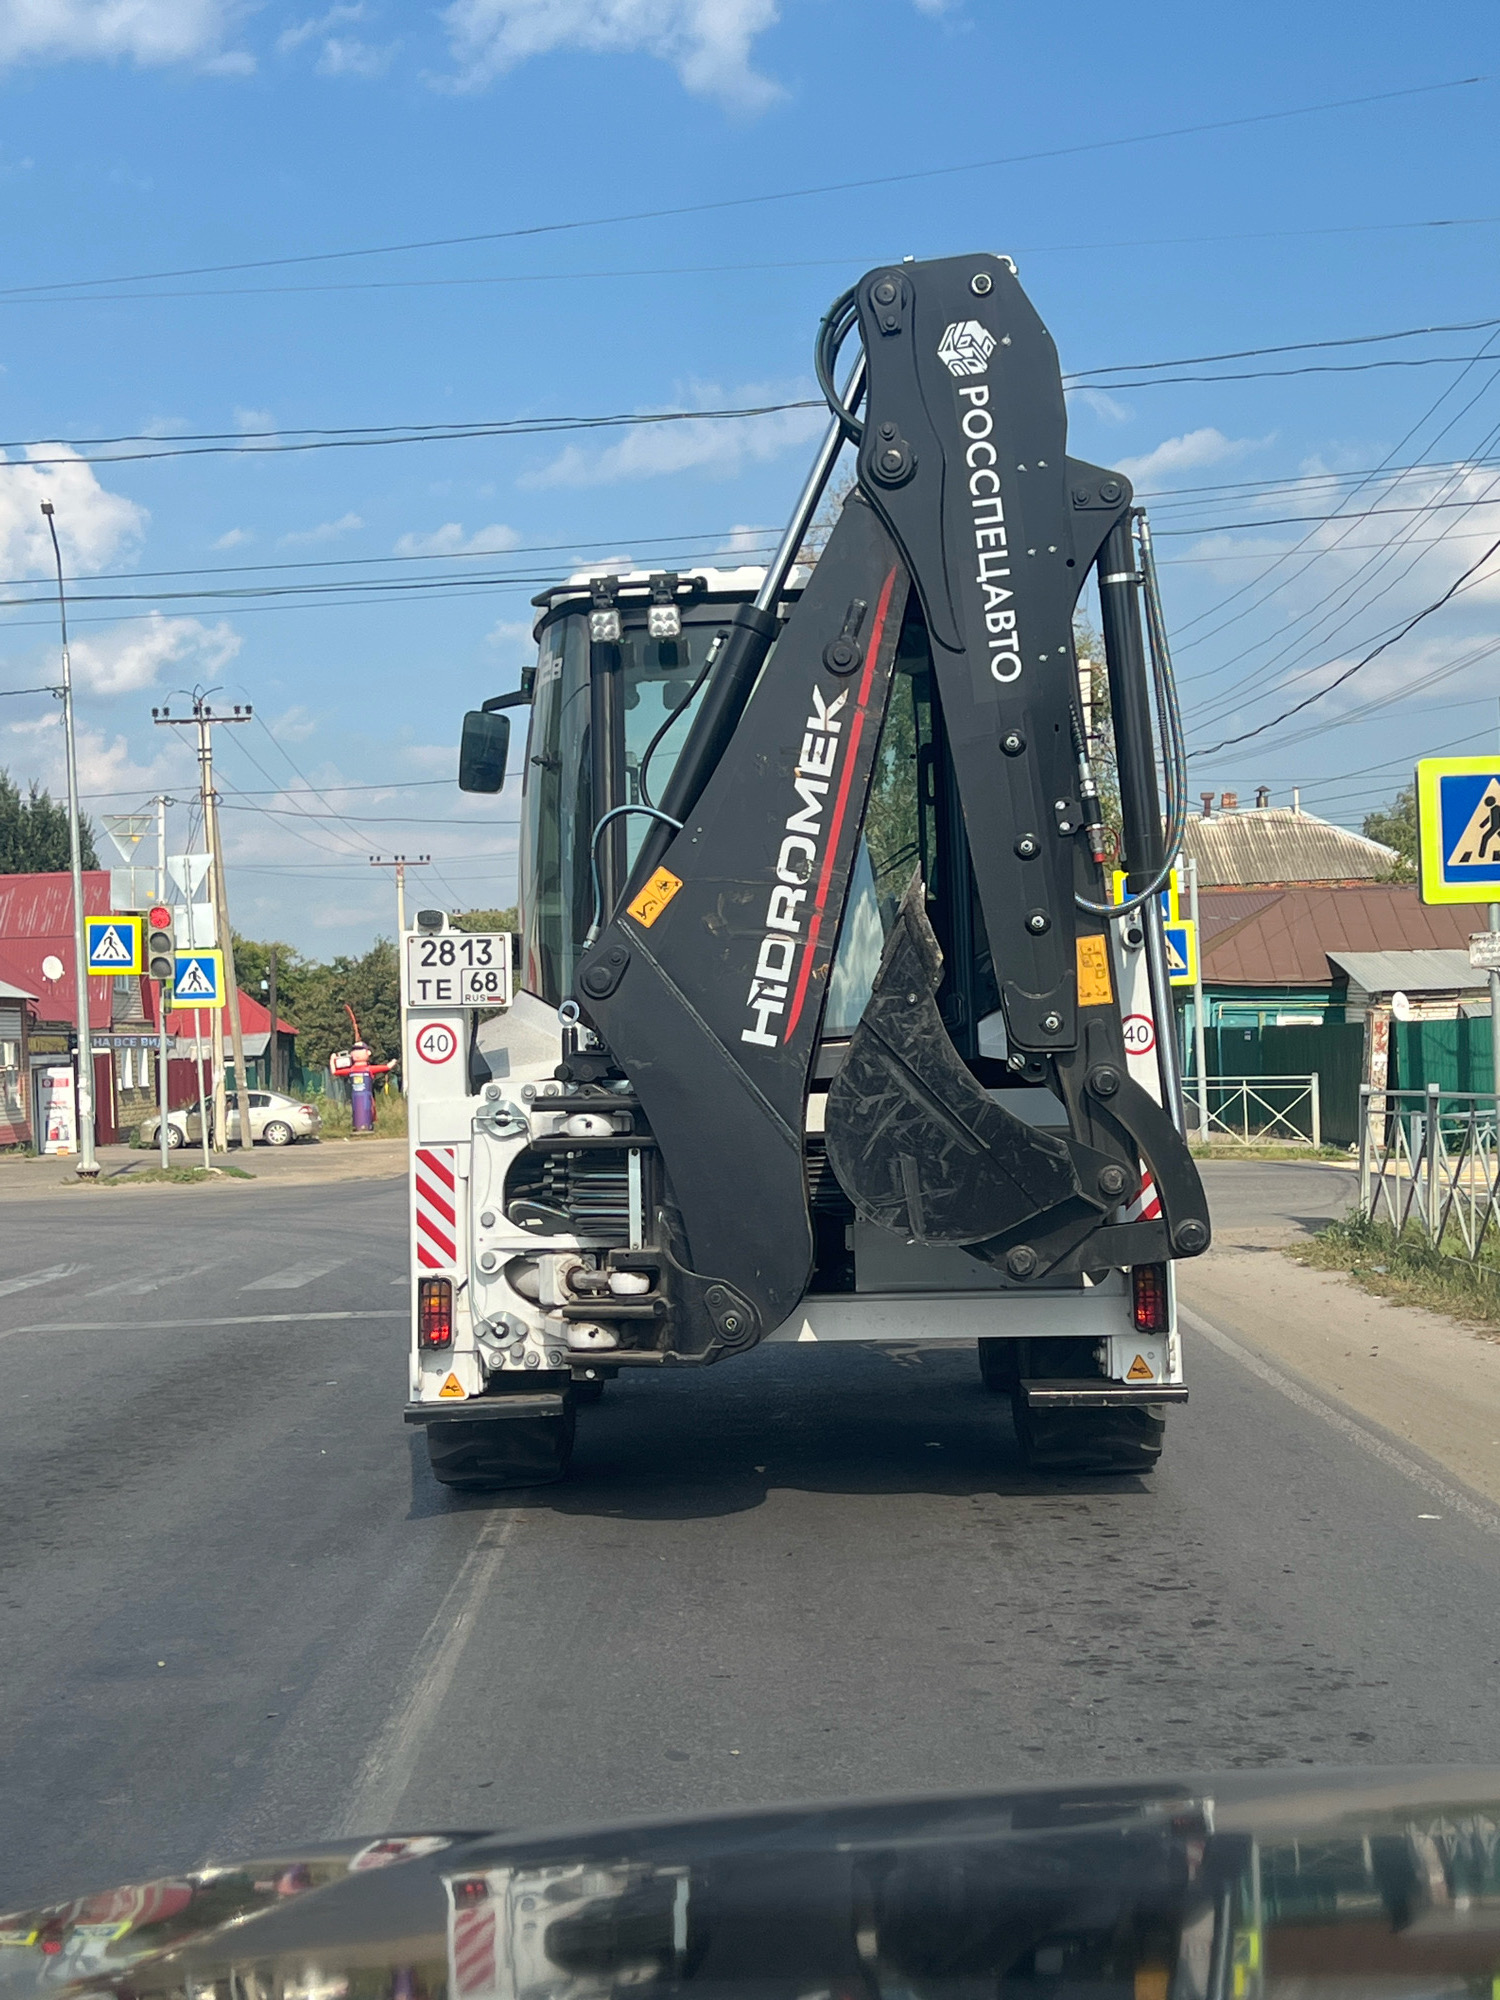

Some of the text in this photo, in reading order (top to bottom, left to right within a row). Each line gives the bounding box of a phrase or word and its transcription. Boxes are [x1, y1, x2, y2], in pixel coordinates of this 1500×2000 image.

[958, 384, 1022, 683] РОССПЕЦАВТО
[421, 939, 492, 967] 2813
[417, 979, 452, 1000] ТЕ
[470, 972, 498, 992] 68
[464, 994, 486, 1002] RUS
[93, 1037, 110, 1047] НА
[114, 1037, 137, 1047] ВСЕ
[423, 1034, 449, 1052] 40
[1123, 1025, 1149, 1043] 40
